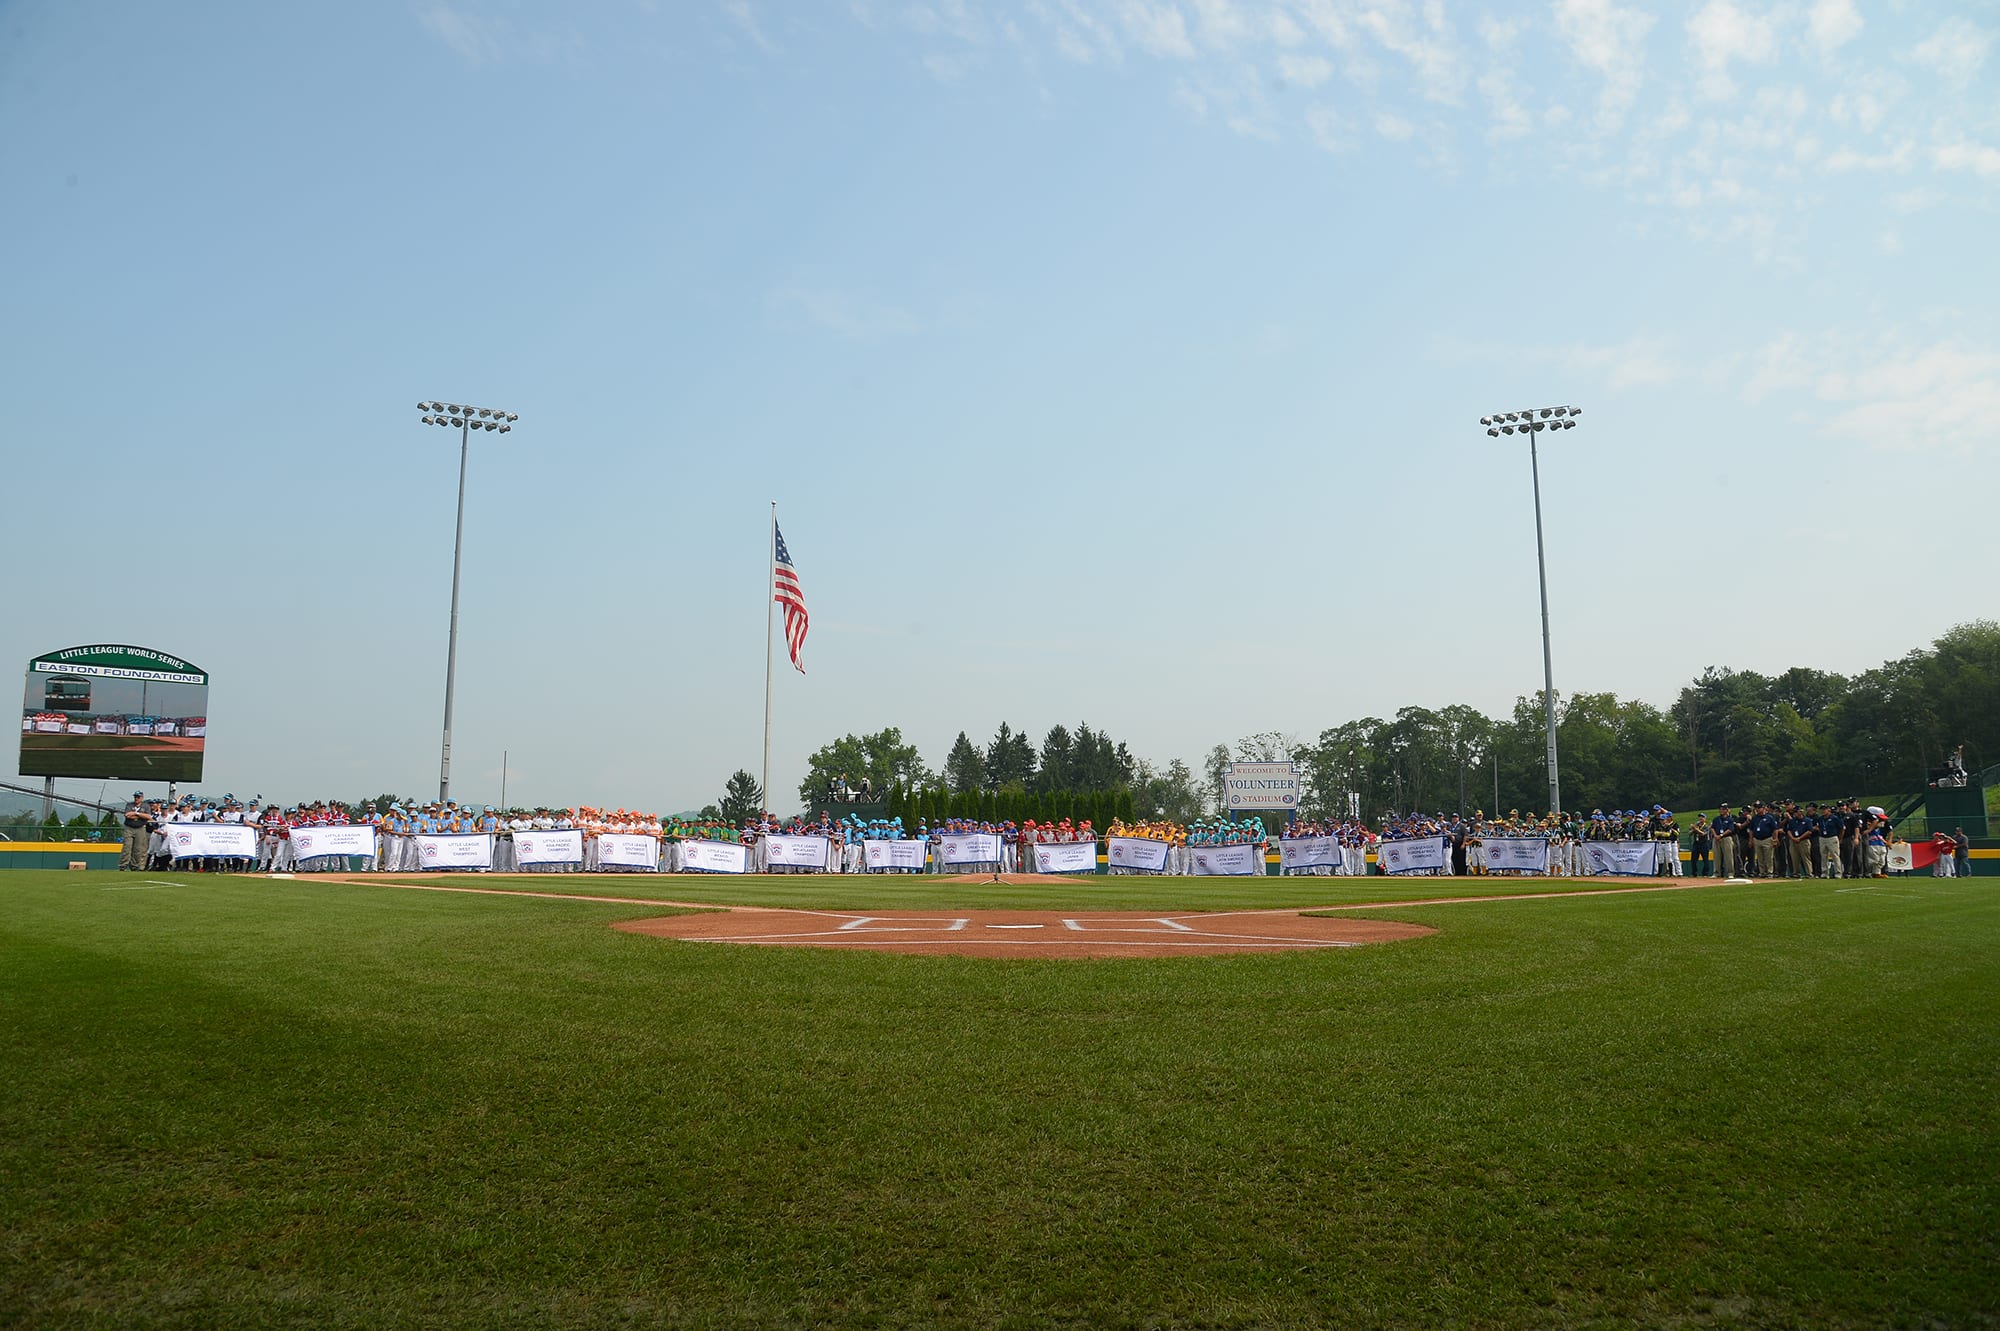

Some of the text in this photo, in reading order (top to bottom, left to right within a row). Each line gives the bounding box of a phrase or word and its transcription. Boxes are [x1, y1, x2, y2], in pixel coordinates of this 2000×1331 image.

[60, 646, 184, 670] LITTLE LEAGUE WORLD SERIES
[39, 663, 201, 682] EASTON FOUNDATIONS
[1229, 780, 1294, 789] VOLUNTEER
